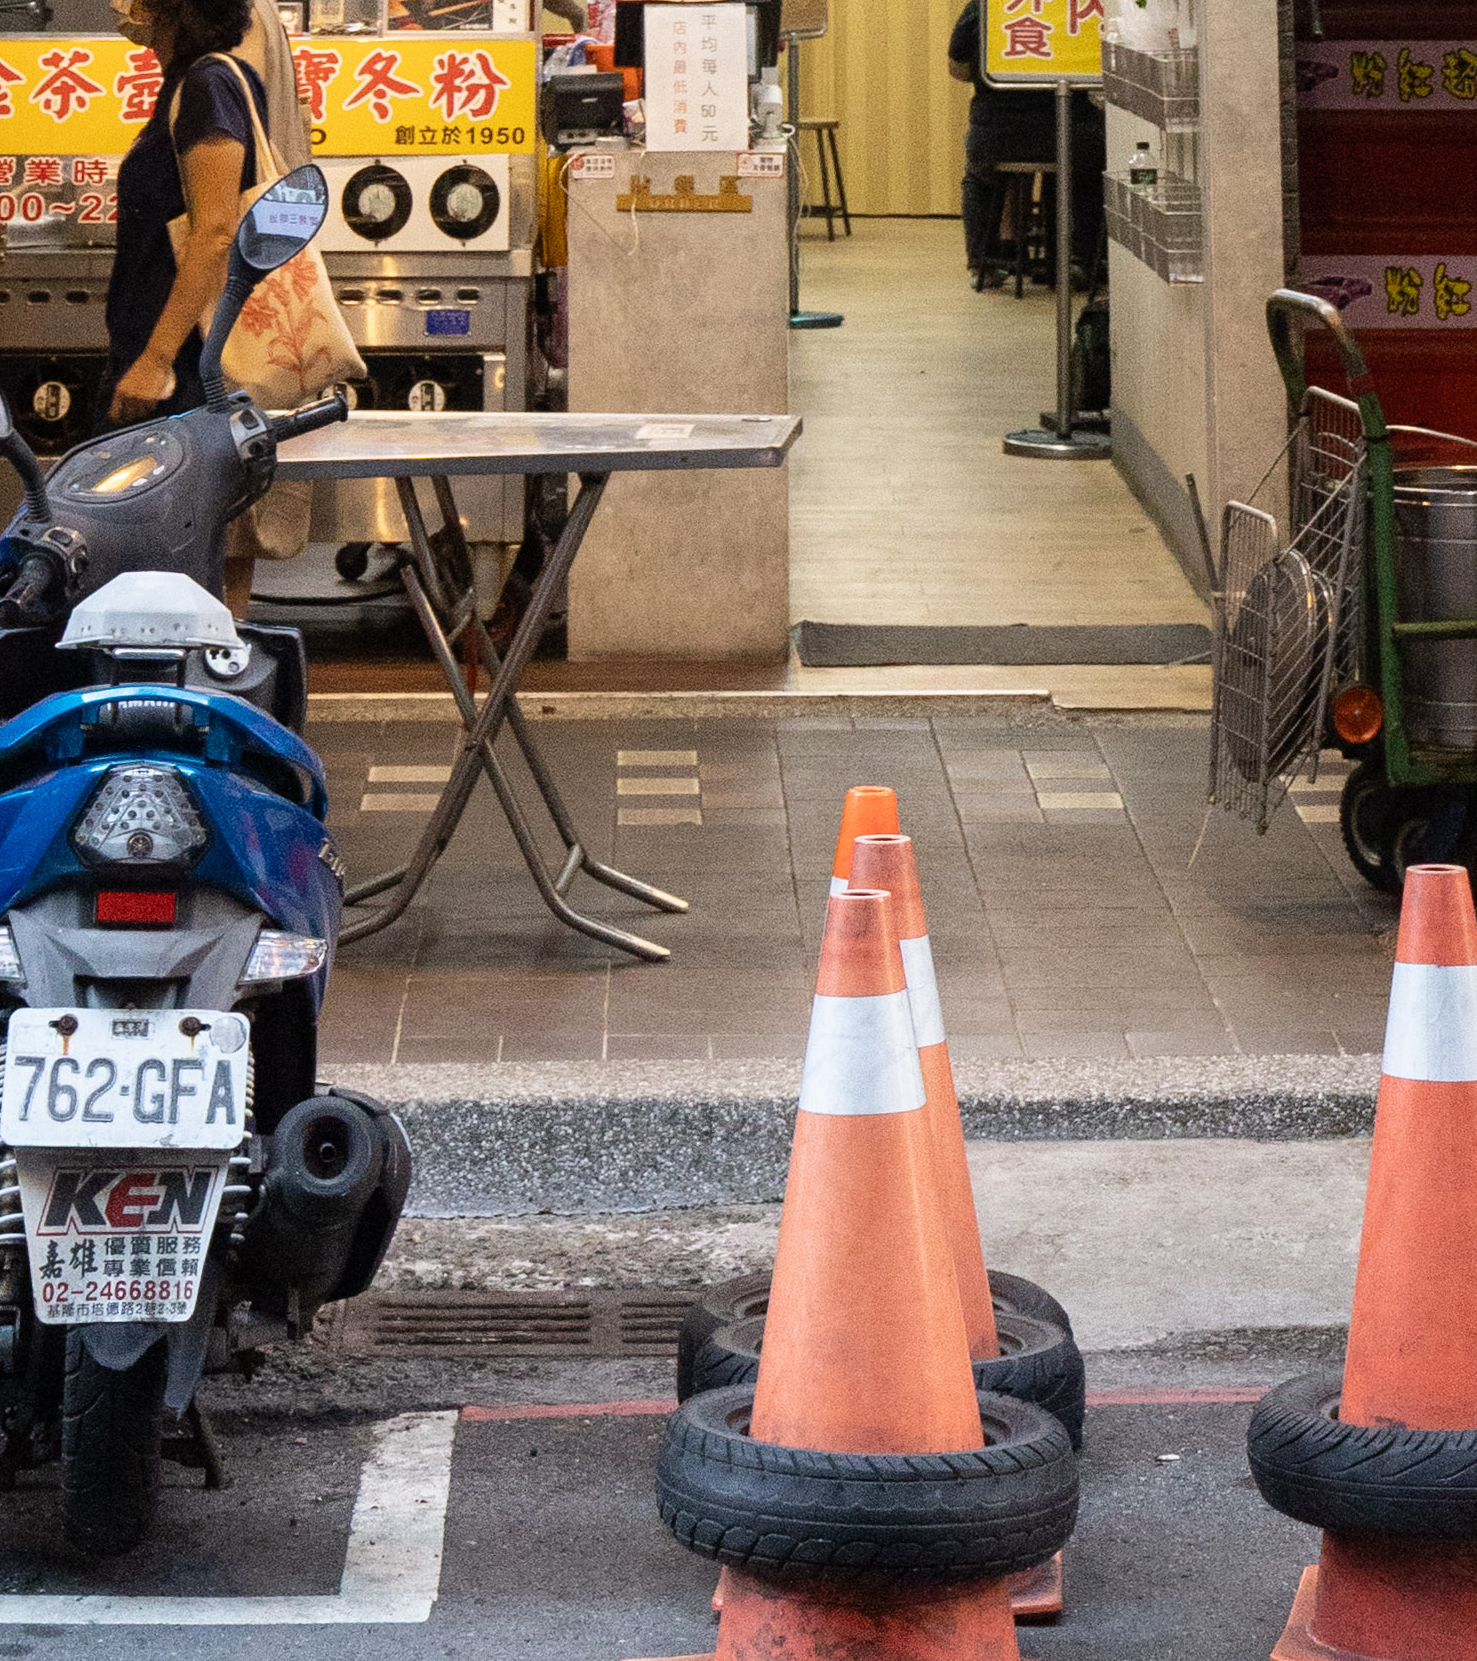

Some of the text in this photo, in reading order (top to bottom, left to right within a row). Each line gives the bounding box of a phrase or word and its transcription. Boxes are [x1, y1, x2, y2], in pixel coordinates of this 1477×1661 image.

[394, 125, 526, 146] 創立於1950
[14, 1056, 237, 1125] 762-GFA
[38, 1168, 219, 1235] KEN
[104, 1235, 202, 1257] 優質服務
[101, 1257, 200, 1278] 專業信賴
[42, 1279, 194, 1303] 02-24668816
